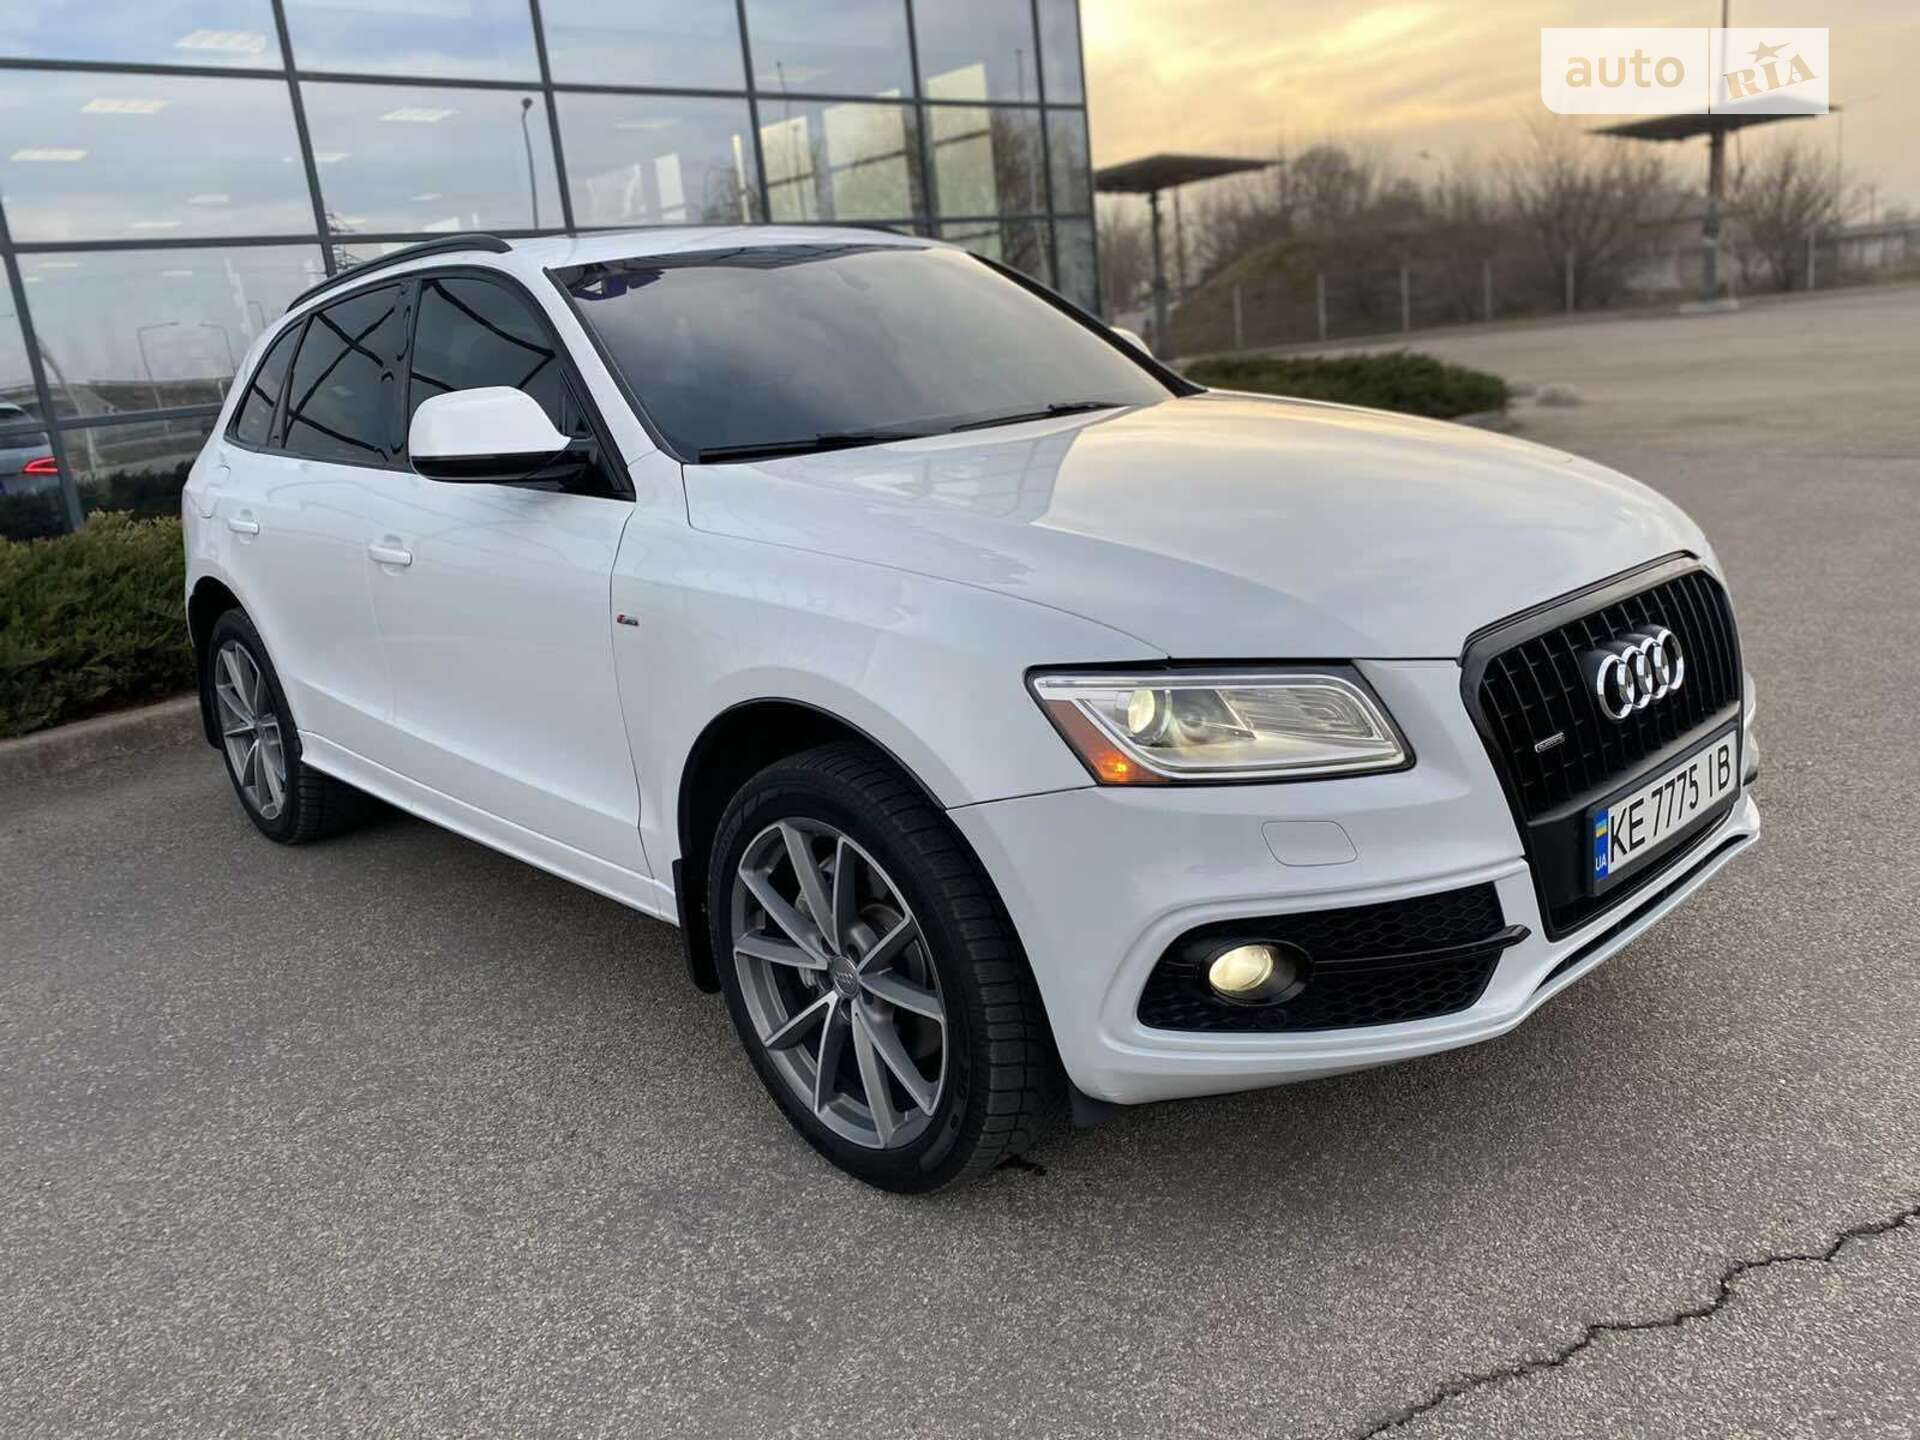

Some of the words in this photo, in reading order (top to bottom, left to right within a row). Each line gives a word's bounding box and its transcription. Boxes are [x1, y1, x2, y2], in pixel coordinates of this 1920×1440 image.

[1610, 798, 1646, 863] KE
[1651, 763, 1699, 837] 7775
[1709, 744, 1731, 797] IB
[1595, 853, 1607, 871] UA
